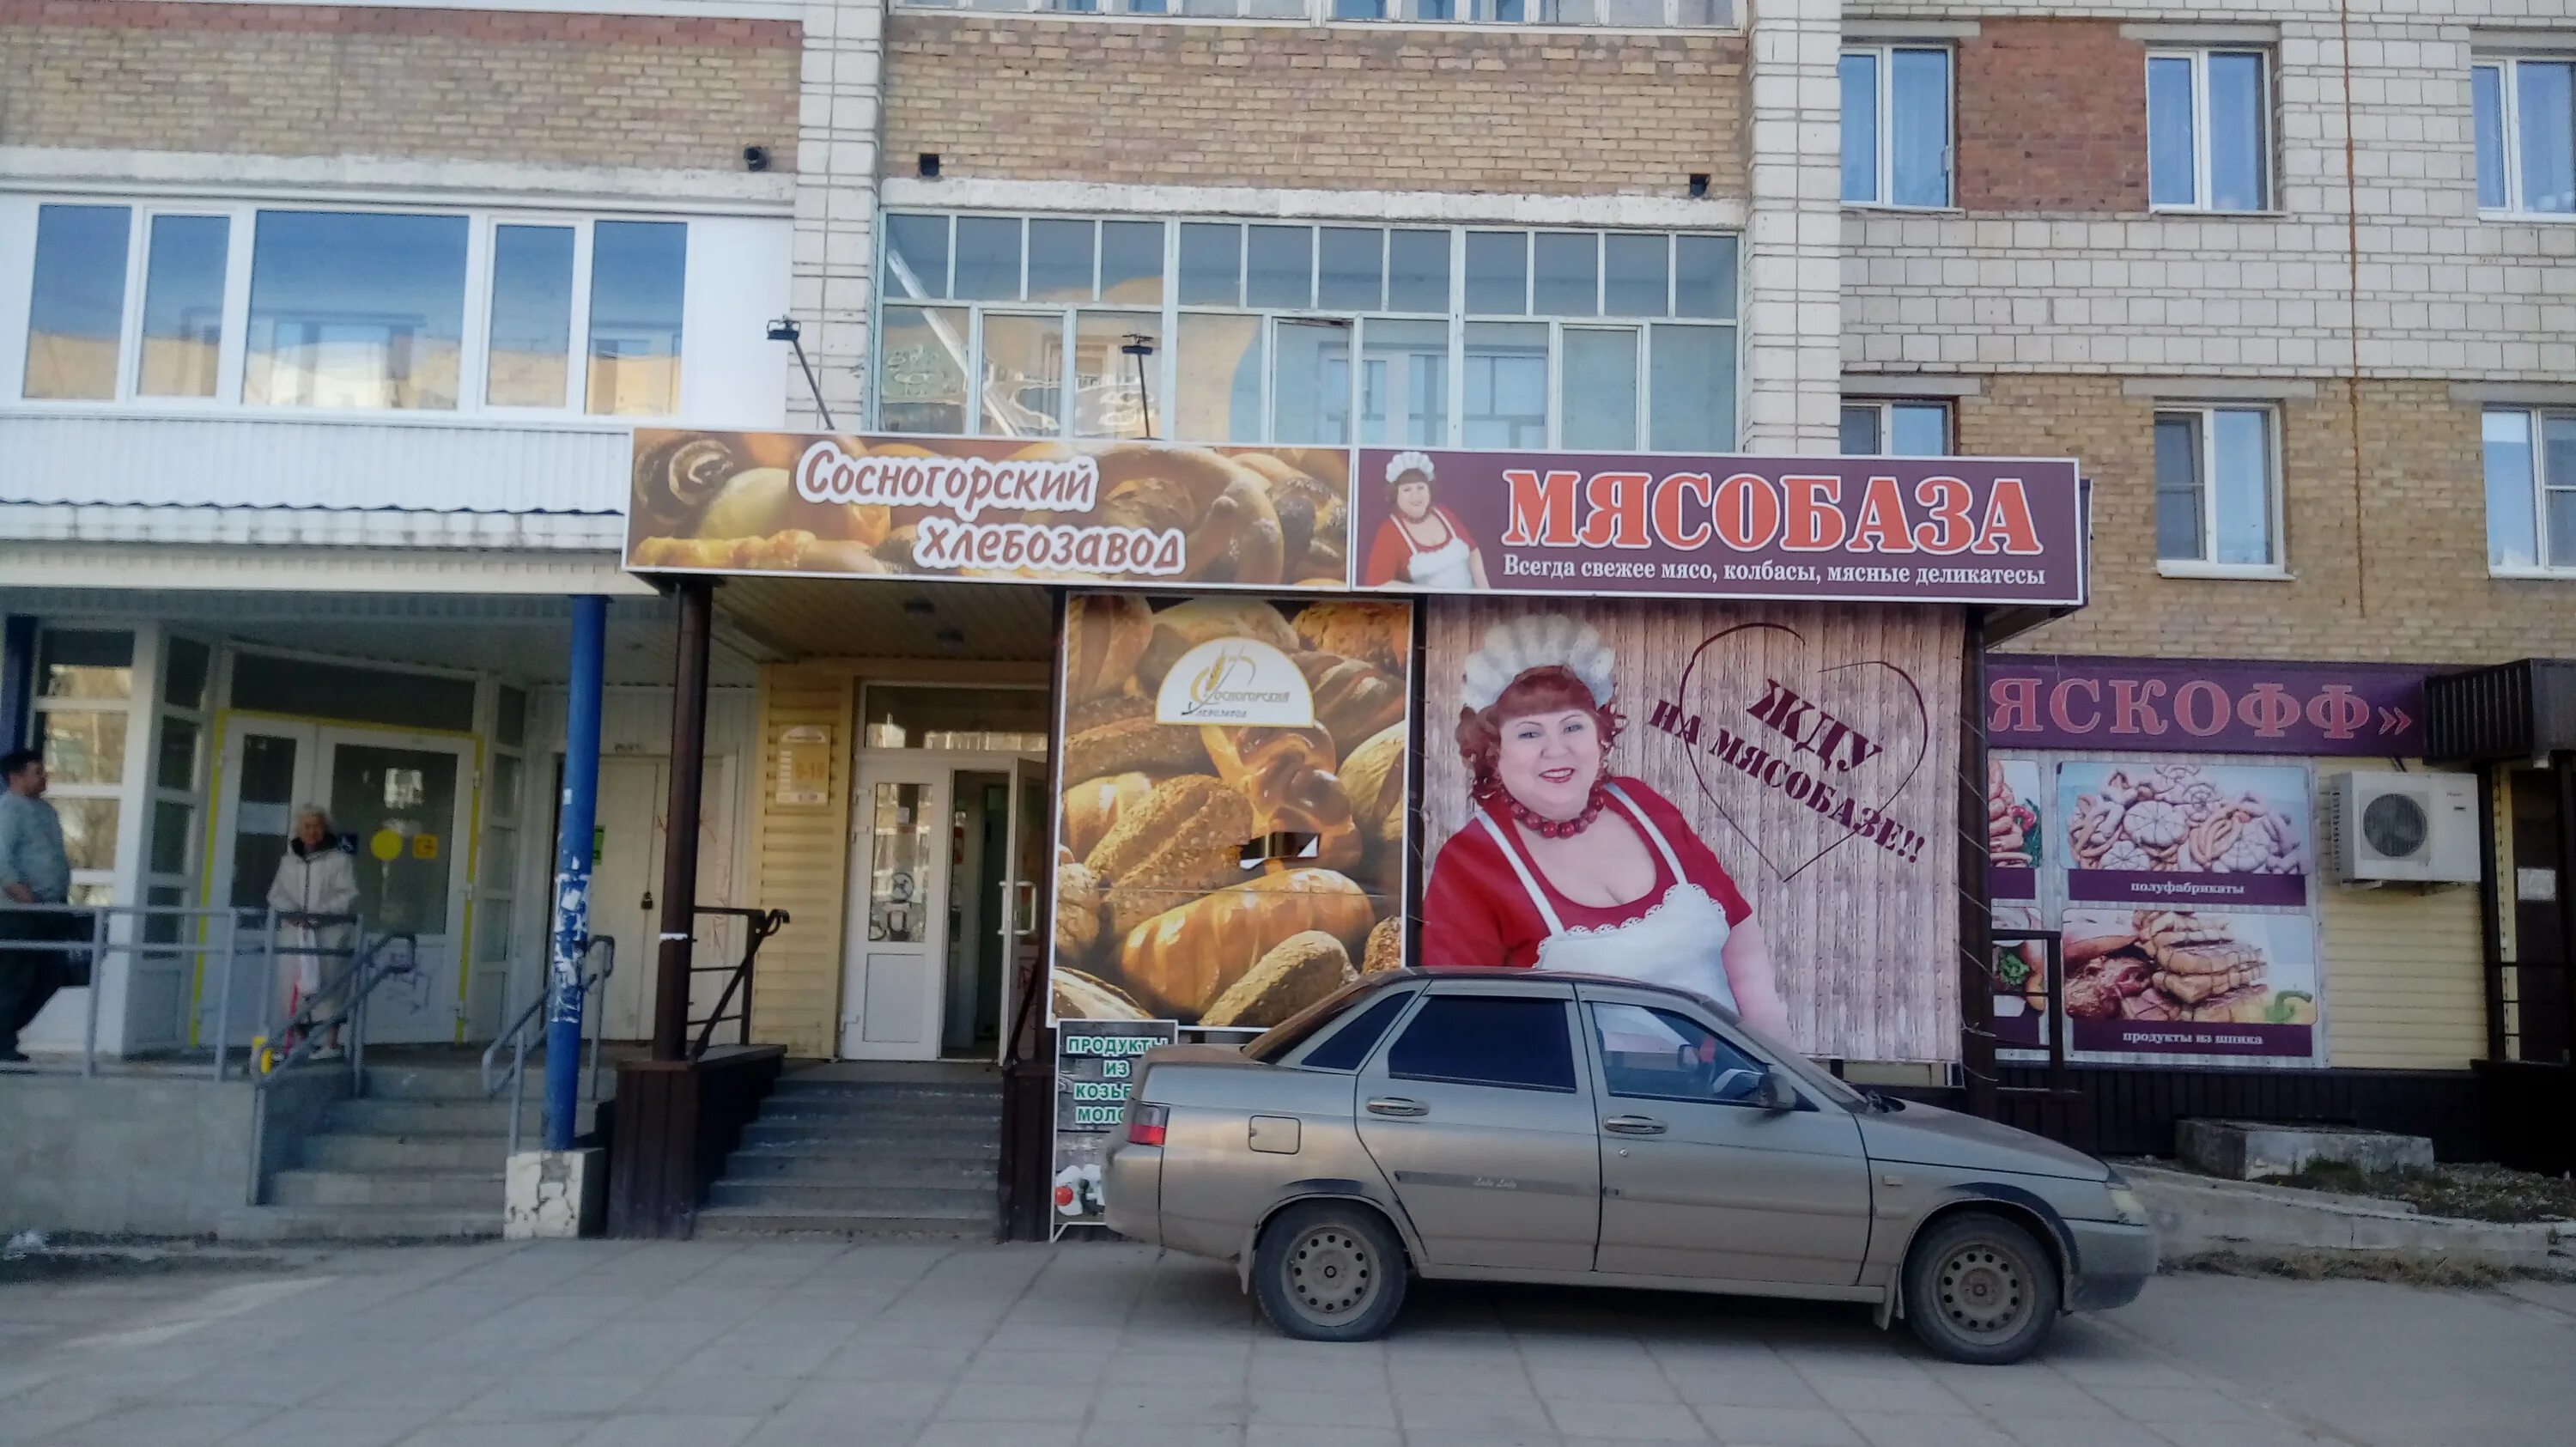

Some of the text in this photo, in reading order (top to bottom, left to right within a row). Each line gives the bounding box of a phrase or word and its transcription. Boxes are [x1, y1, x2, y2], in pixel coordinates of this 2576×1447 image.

[798, 443, 1097, 516] Сосногорский
[1501, 469, 2044, 556] МЯСОБАЗА
[1504, 554, 2045, 587] Всегда свежее мясо, колбасы, мясные деликатесы
[1747, 678, 1883, 772] ЖДУ
[1649, 699, 1925, 863] НА МЯСОБАЗЕ!!
[2130, 880, 2245, 895] полуфабрикаты
[2123, 1032, 2193, 1044] продукты
[1103, 1060, 1131, 1078] ИЗ
